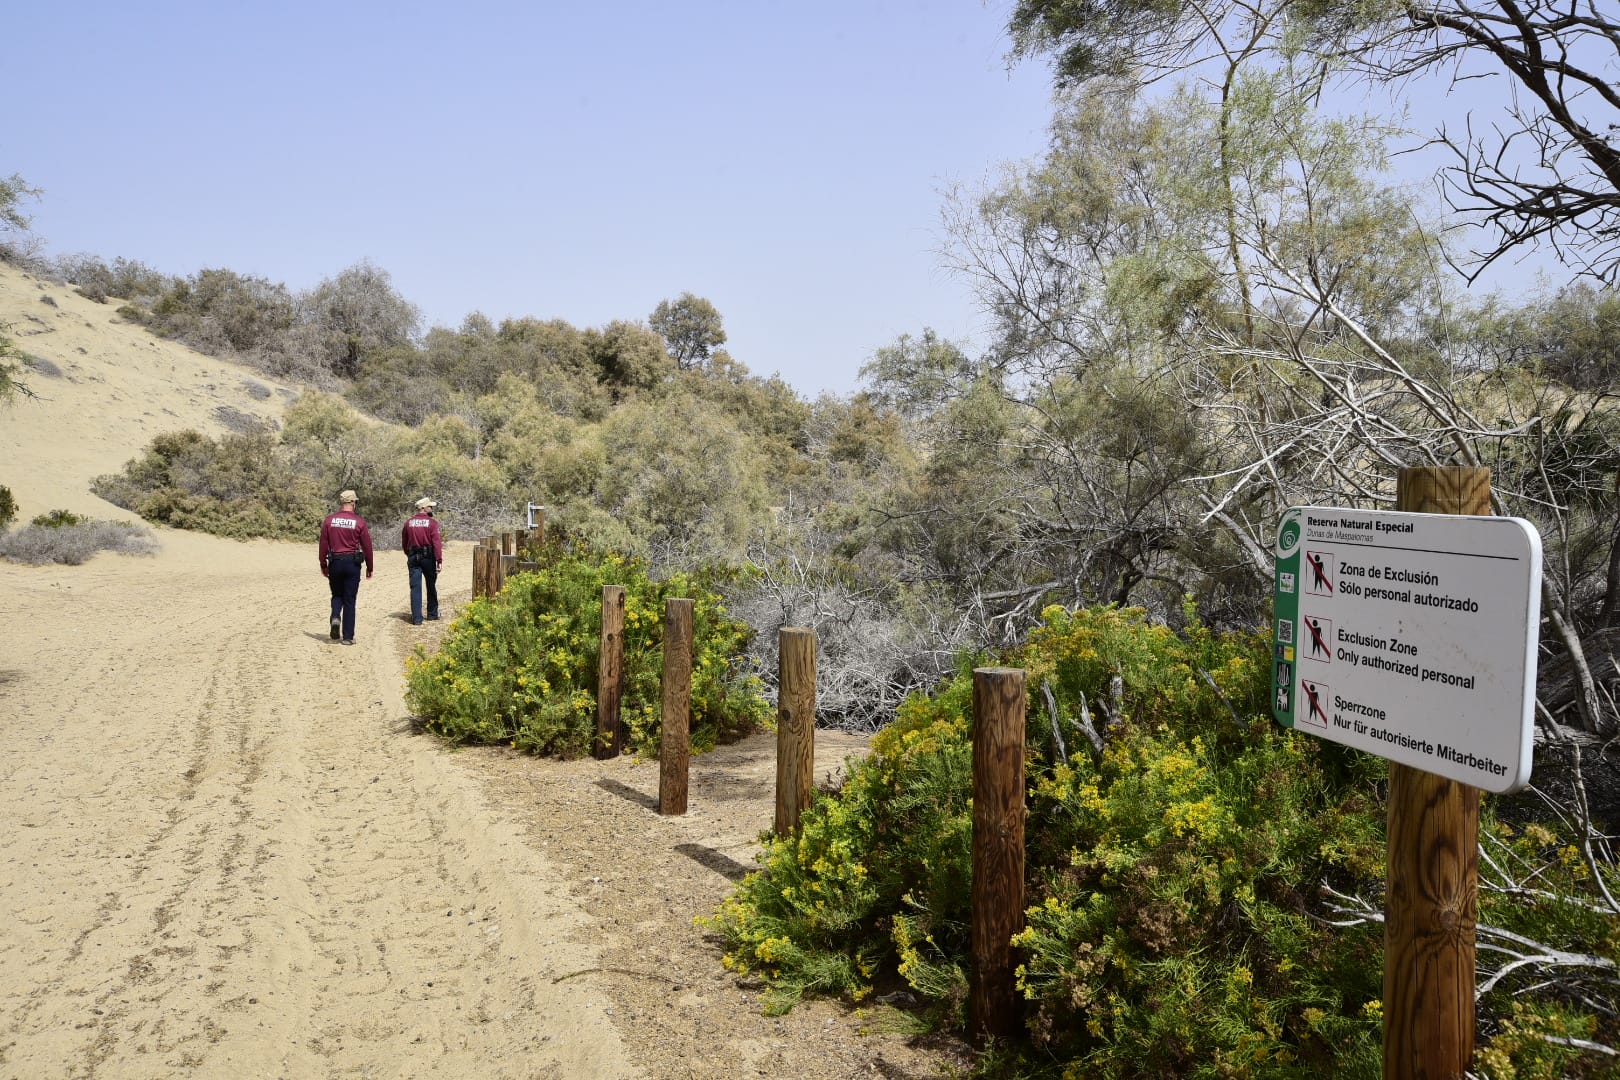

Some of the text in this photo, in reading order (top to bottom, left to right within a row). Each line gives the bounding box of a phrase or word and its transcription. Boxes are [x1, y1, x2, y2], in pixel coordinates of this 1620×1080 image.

[1306, 528, 1325, 538] Dunas
[1325, 529, 1334, 539] de
[1307, 516, 1414, 534] Reserva Natural Especial
[1339, 561, 1439, 586] Zona de Exclusión
[1339, 580, 1479, 613] Sólo personal autorizado
[1337, 628, 1418, 656] Exclusion Zone
[1337, 647, 1475, 690] Only authorized personal
[1334, 695, 1386, 721] Sperrzone
[1333, 713, 1508, 777] Nur für autorisierte Mitarbeiter
